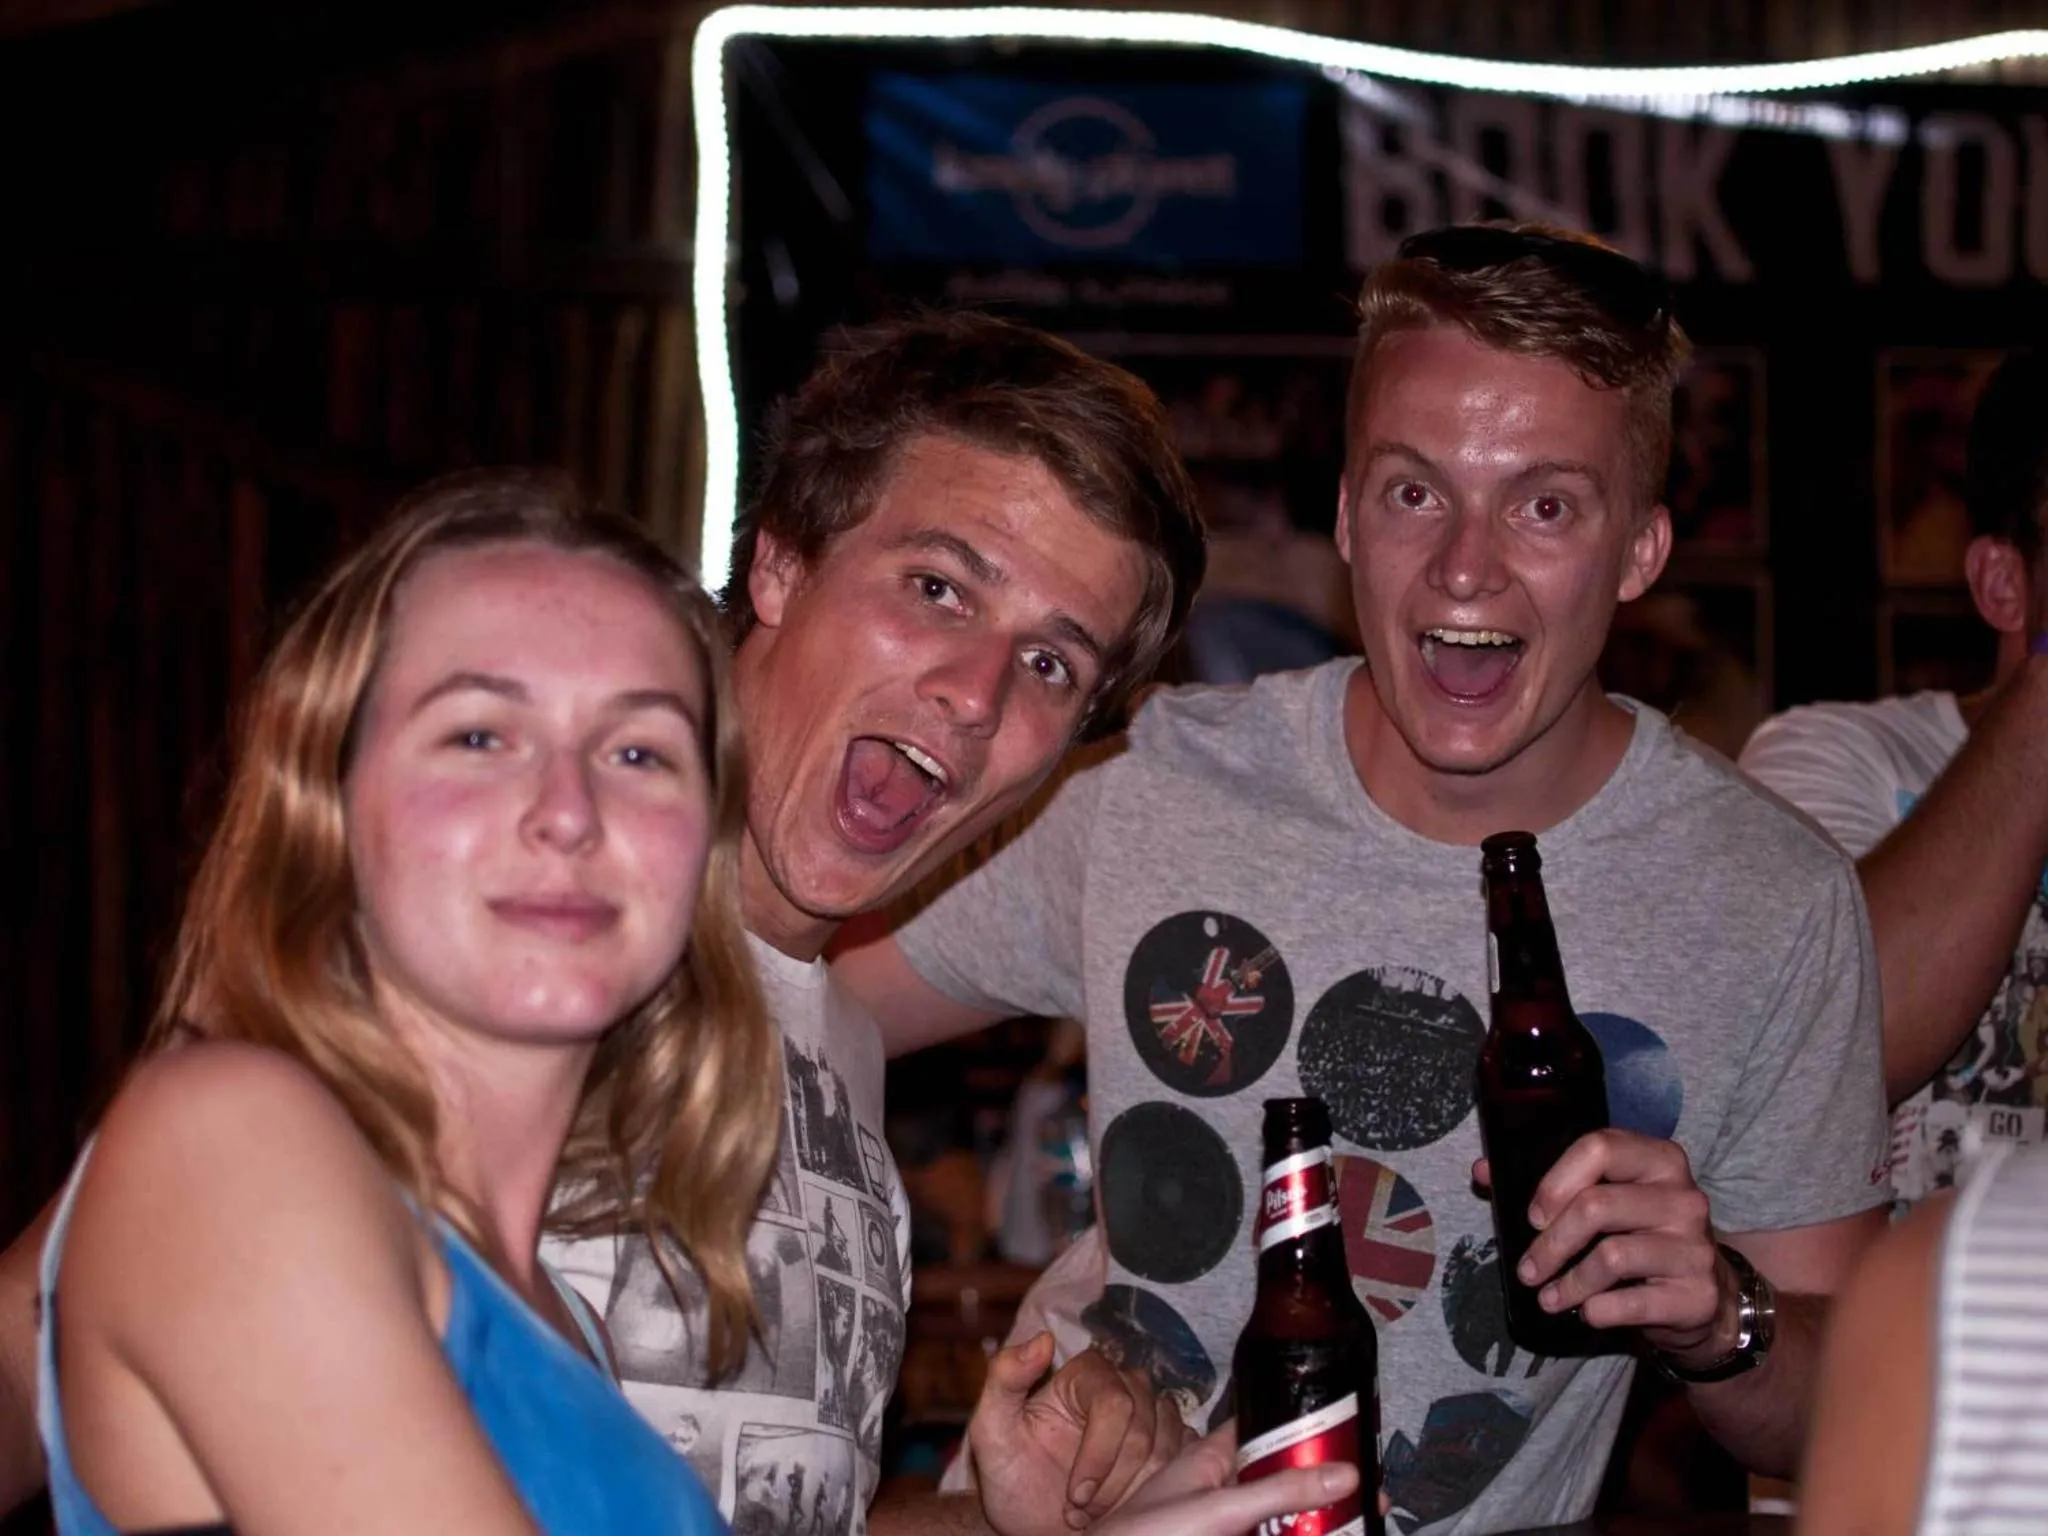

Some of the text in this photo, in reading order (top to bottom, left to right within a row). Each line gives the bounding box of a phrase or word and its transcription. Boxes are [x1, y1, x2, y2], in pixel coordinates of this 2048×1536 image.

[1342, 92, 1756, 283] BOOK
[1822, 110, 2048, 287] YO
[1988, 1111, 2023, 1137] GO
[1266, 1184, 1308, 1216] Pils
